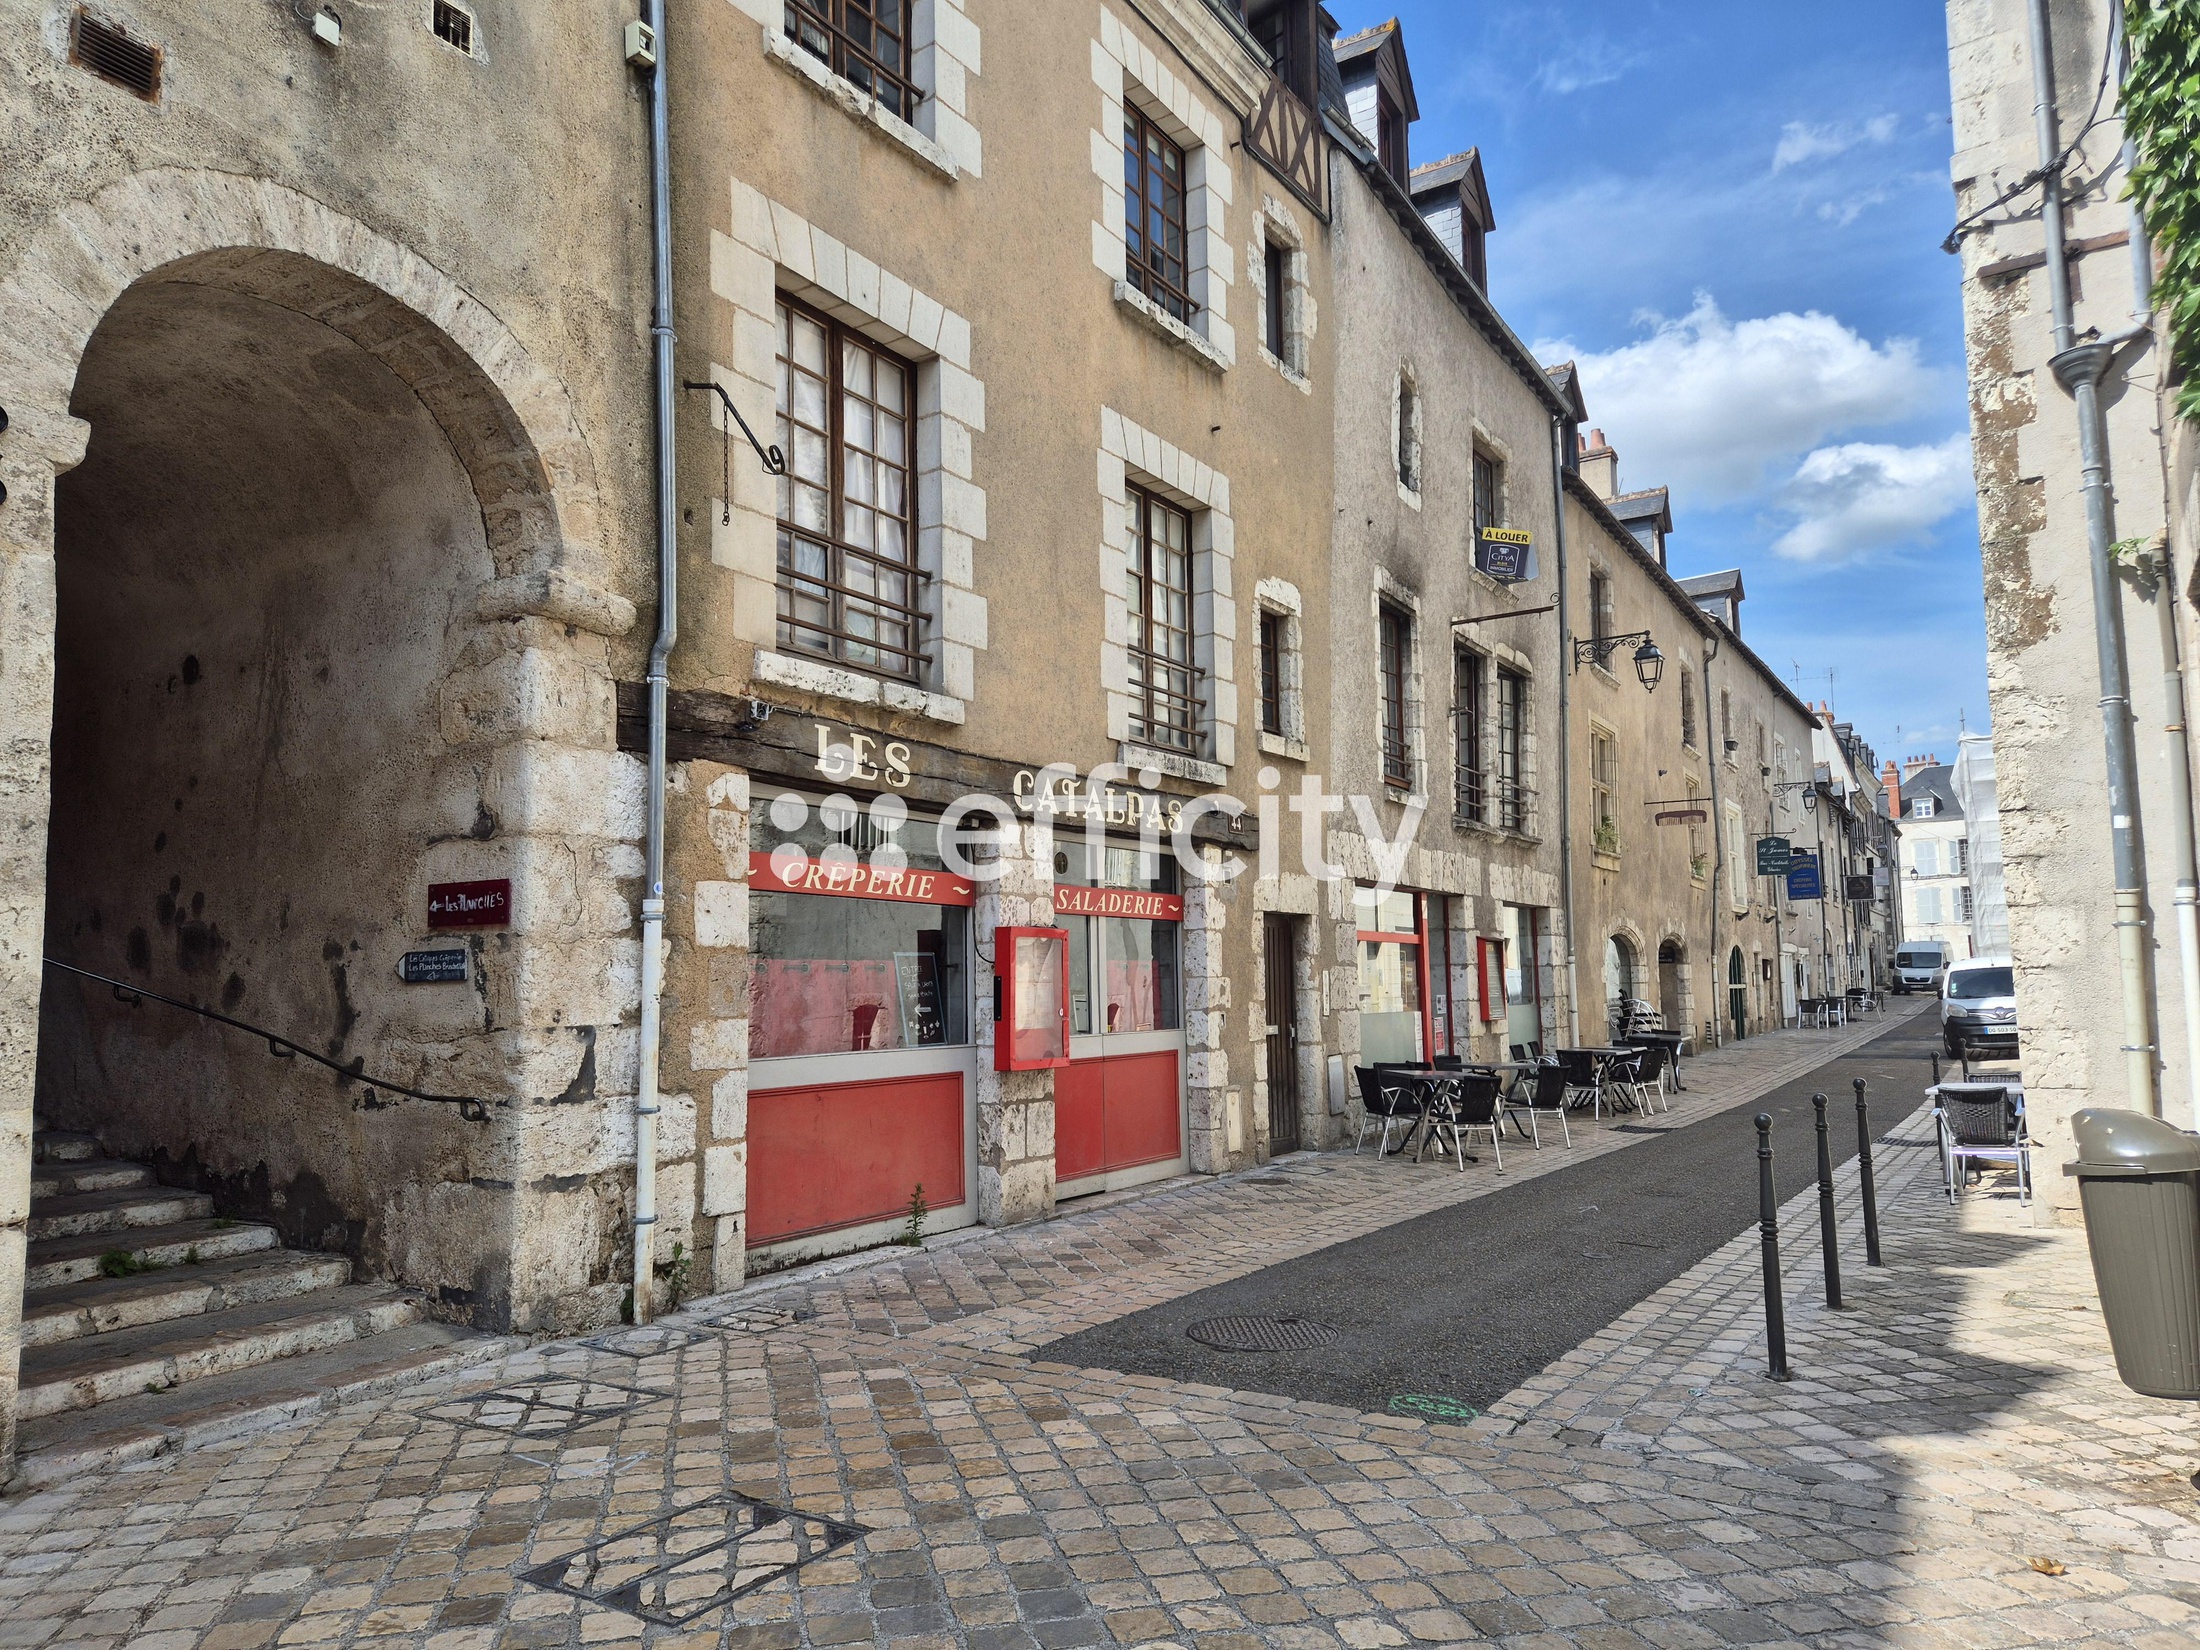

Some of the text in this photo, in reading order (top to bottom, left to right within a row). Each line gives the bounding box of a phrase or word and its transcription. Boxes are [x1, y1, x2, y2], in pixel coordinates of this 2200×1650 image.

[1485, 529, 1528, 543] À LOUER
[813, 723, 1184, 834] LES CATALPAS
[782, 862, 936, 899] CRÊPERIE
[1056, 888, 1164, 916] SALADERIE
